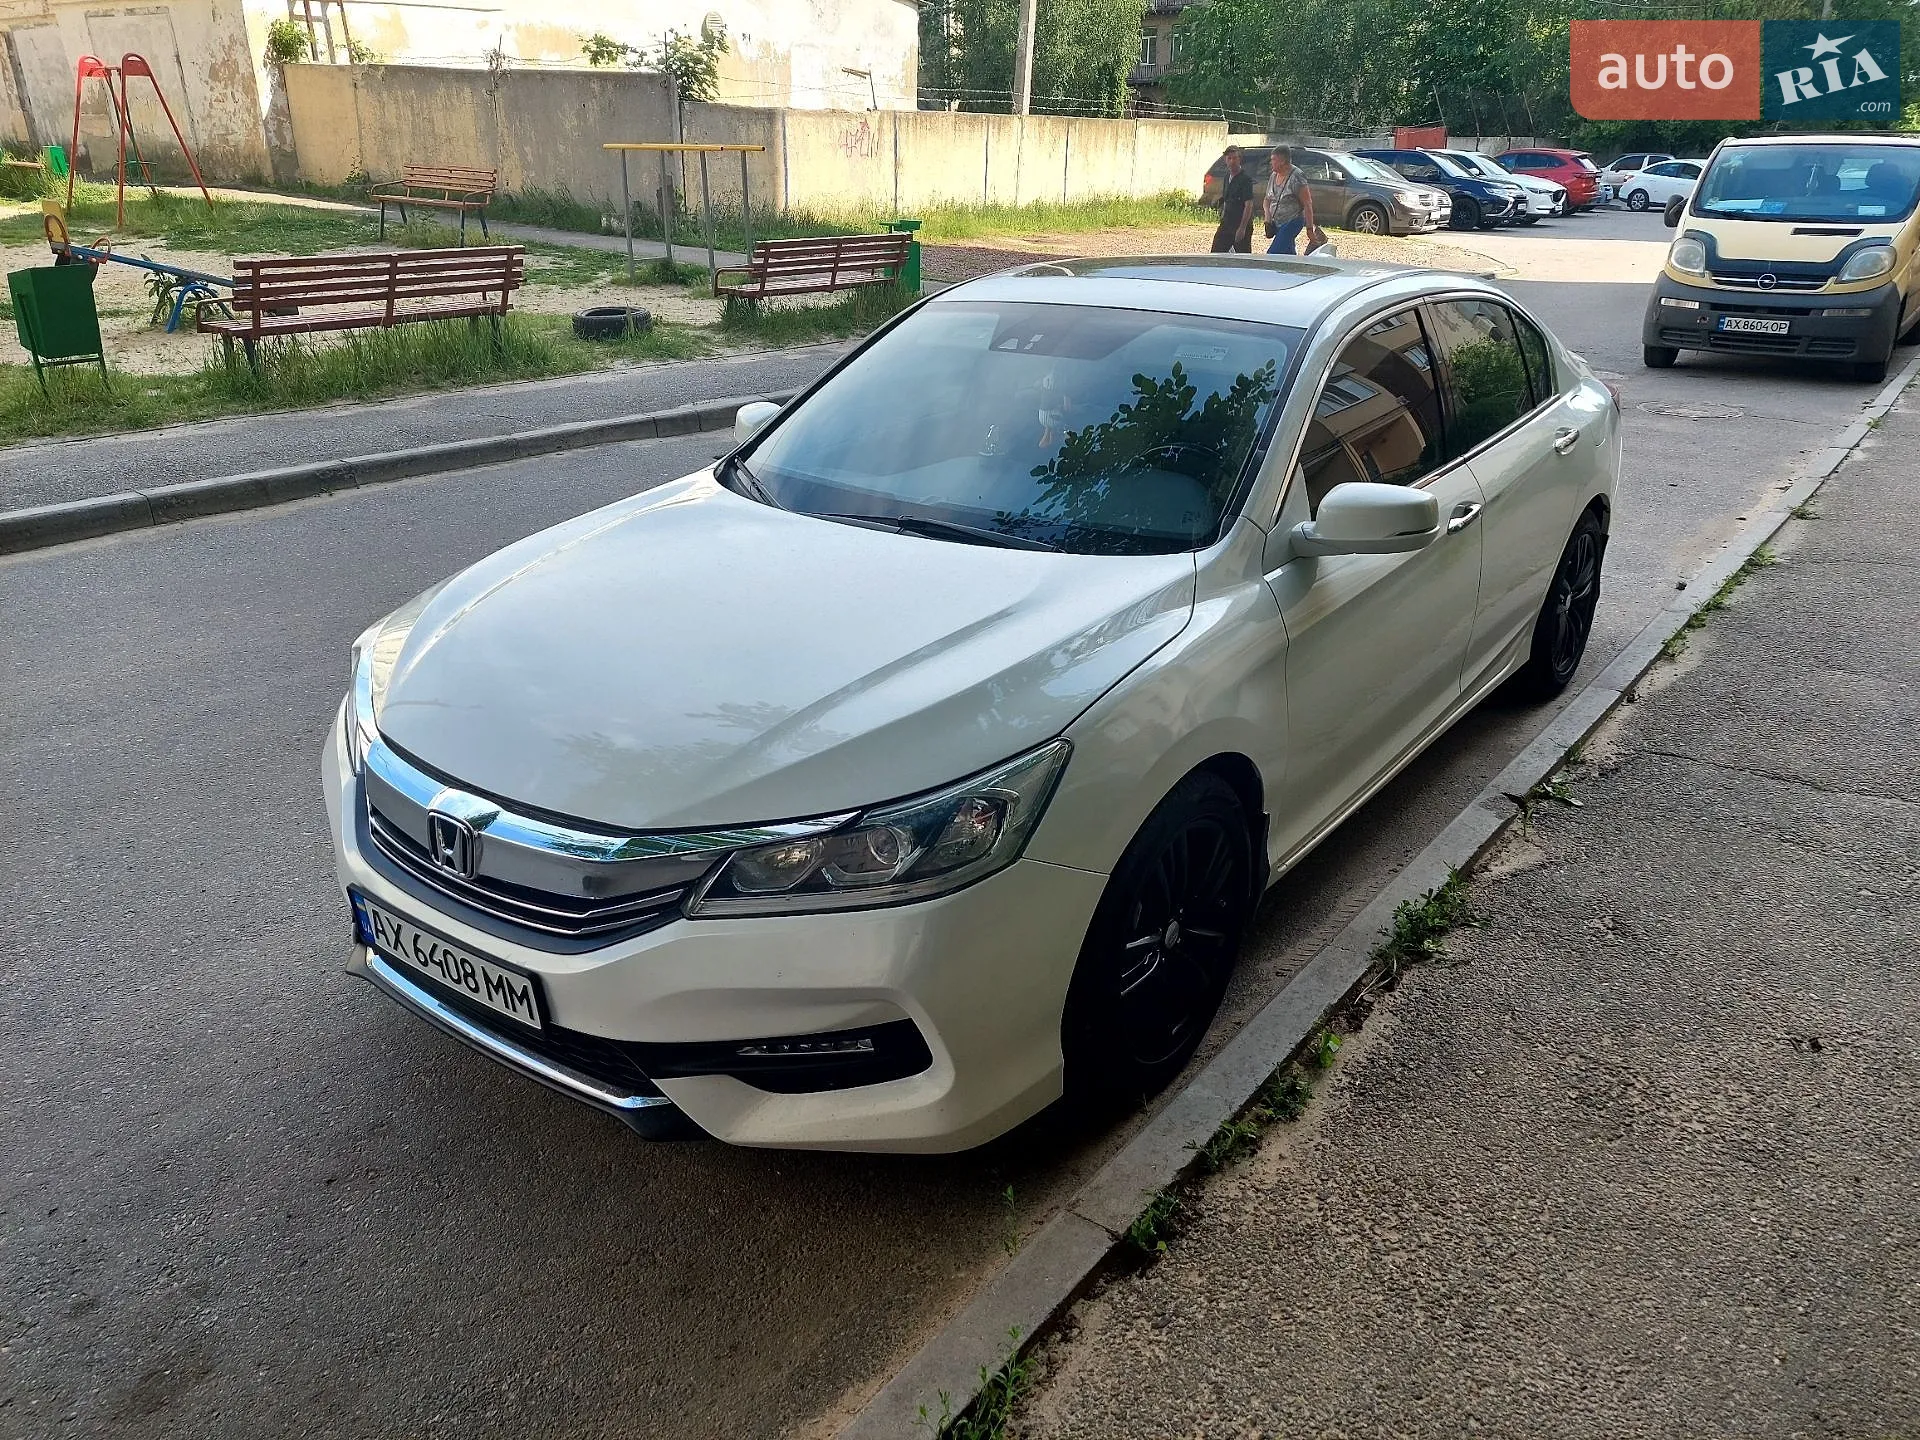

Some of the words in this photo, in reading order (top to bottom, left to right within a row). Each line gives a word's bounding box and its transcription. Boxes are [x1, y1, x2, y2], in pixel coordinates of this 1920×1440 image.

[1725, 319, 1742, 330] AX
[1743, 320, 1769, 332] 8604
[1771, 322, 1788, 332] OP
[371, 908, 410, 958] AX
[412, 934, 480, 994] 6408
[480, 965, 535, 1021] MM
